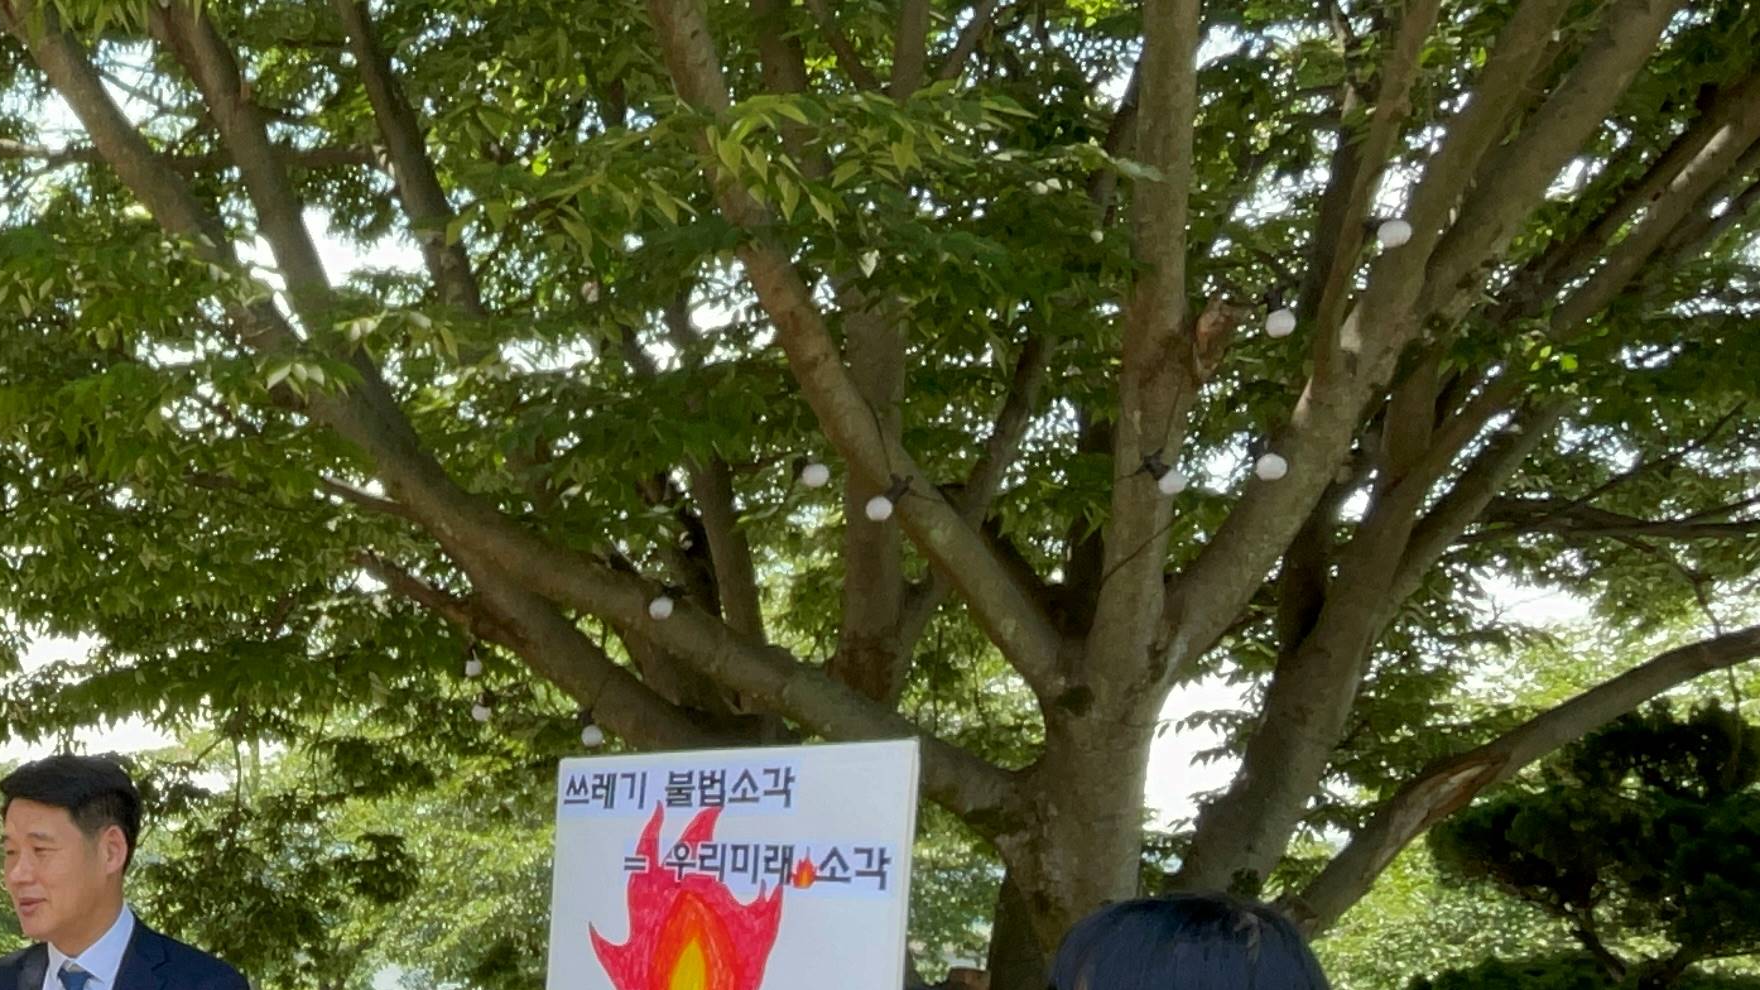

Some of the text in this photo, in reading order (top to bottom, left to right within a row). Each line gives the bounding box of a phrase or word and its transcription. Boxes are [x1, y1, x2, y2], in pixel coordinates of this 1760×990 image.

[562, 766, 796, 810] 쓰레기 불법소각
[666, 842, 795, 884] 우리미래
[816, 845, 892, 891] 소각
